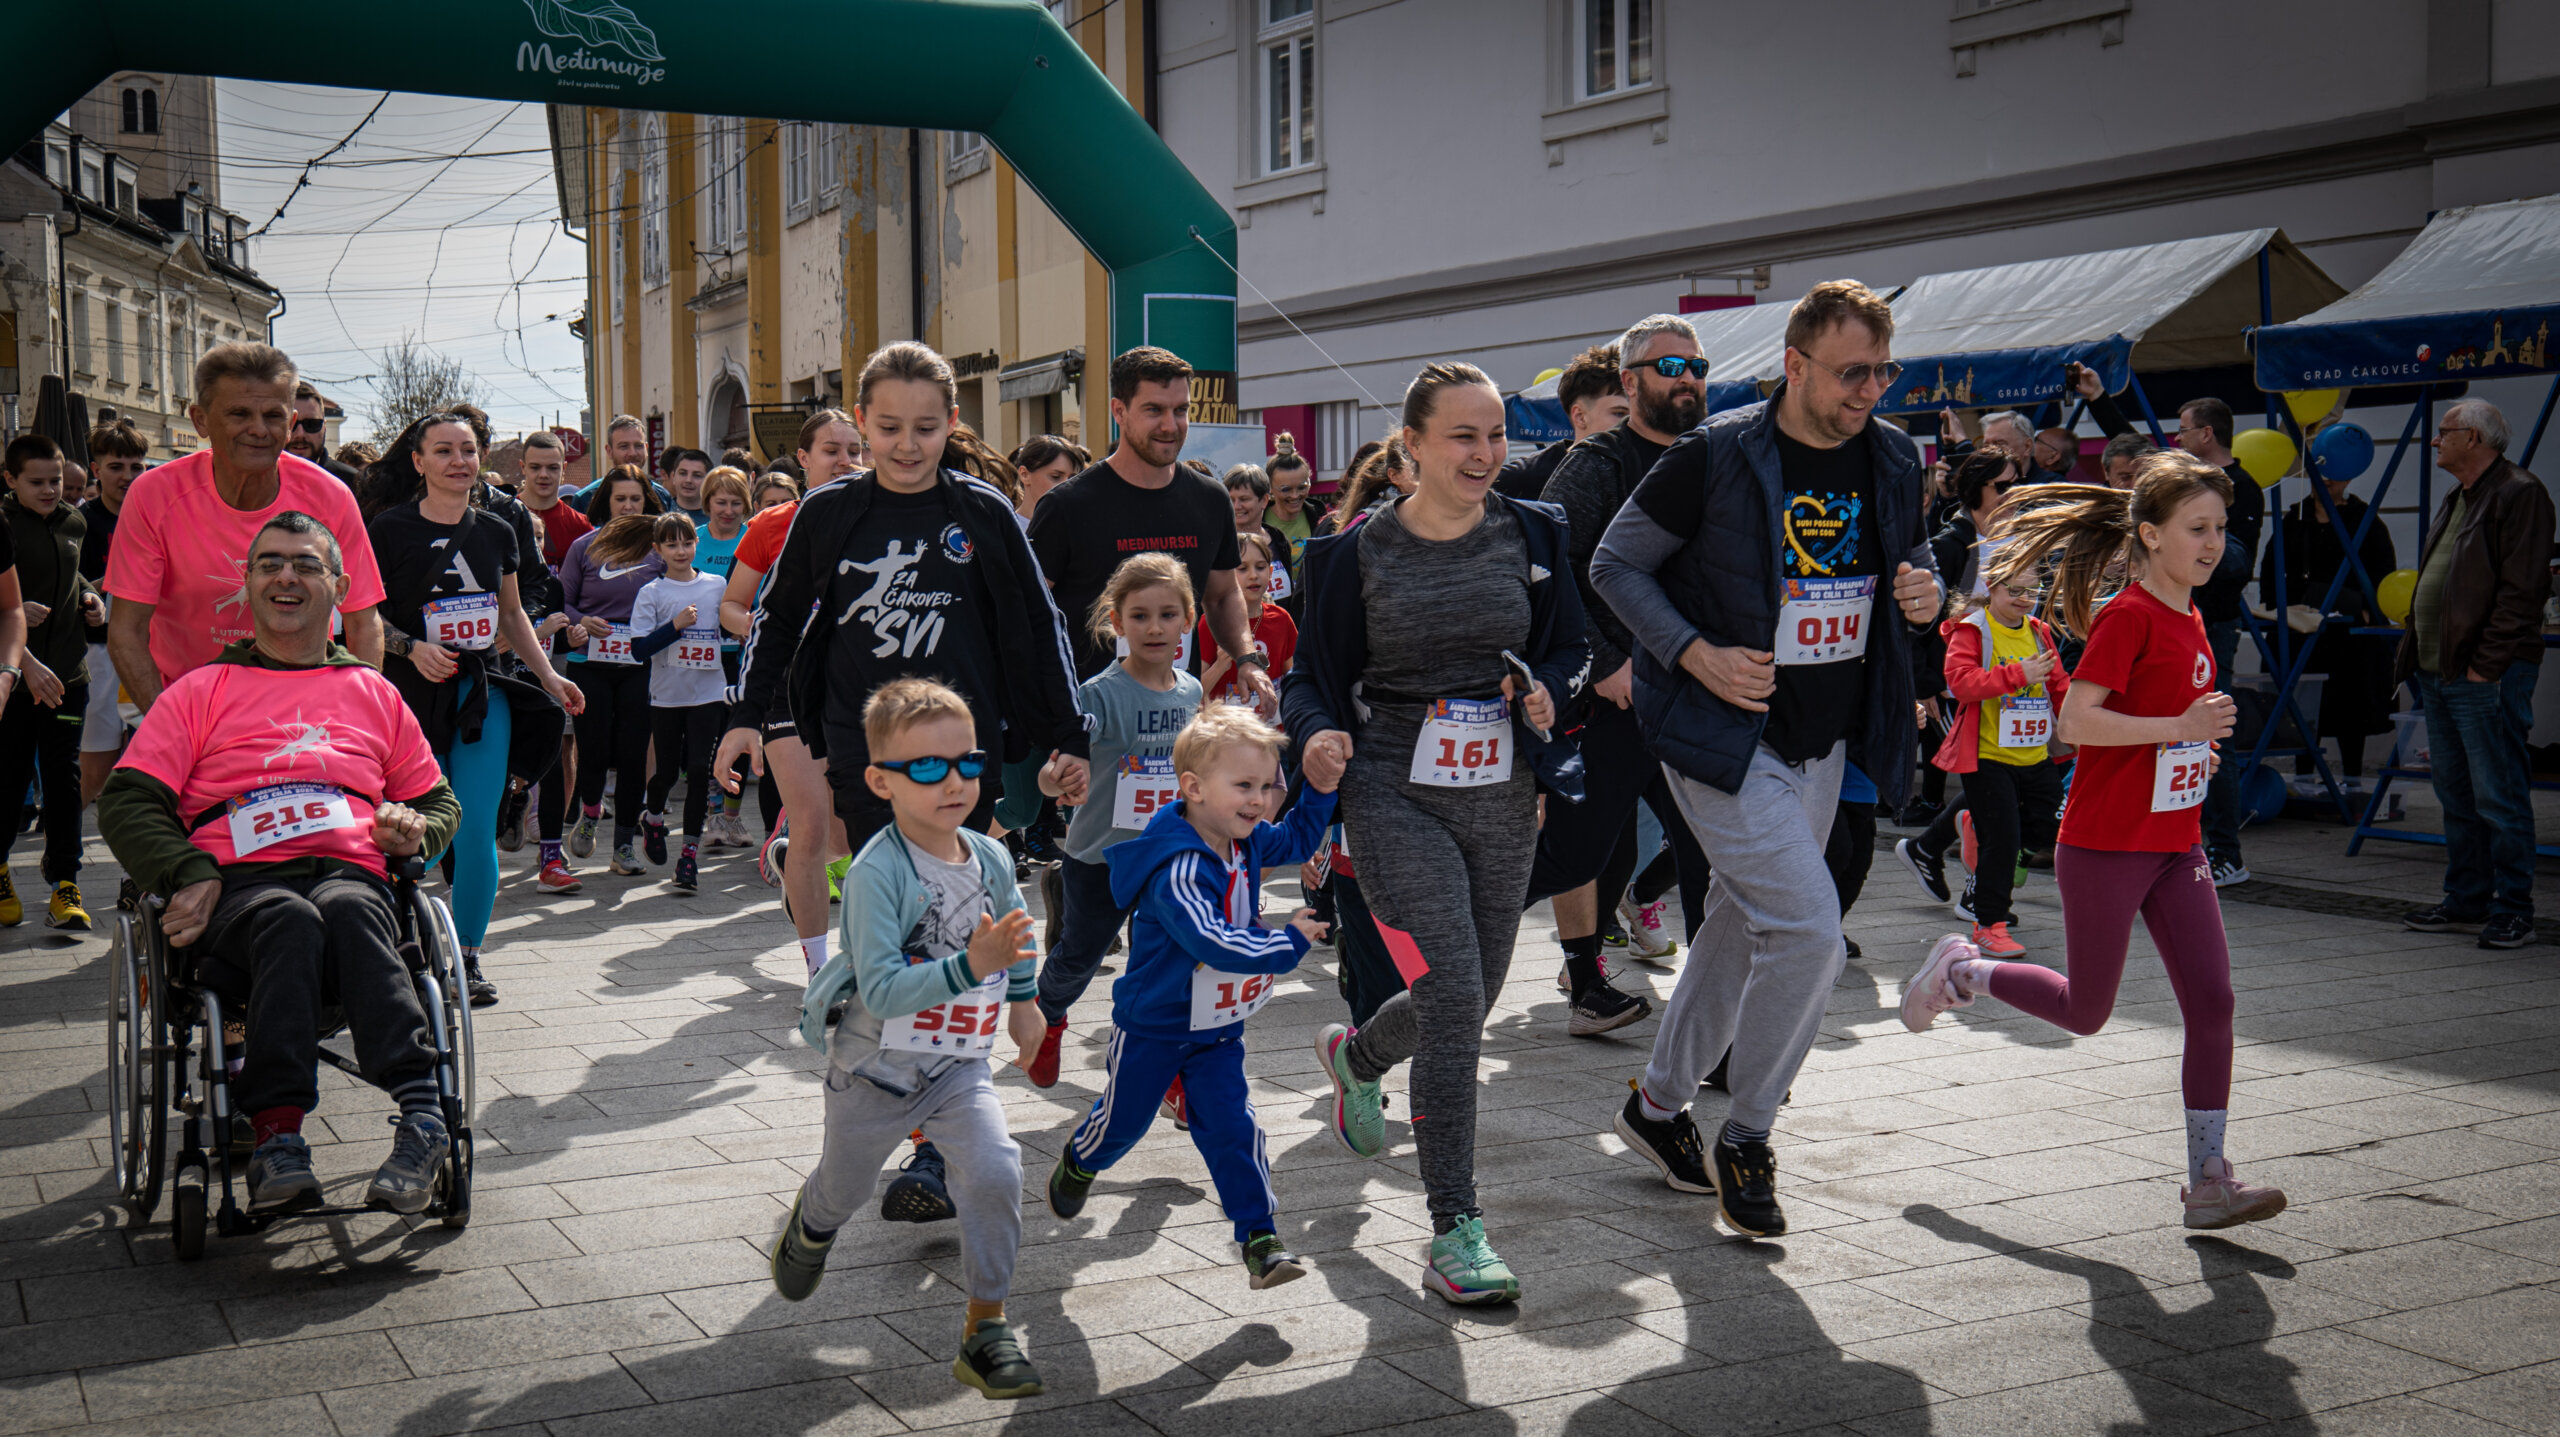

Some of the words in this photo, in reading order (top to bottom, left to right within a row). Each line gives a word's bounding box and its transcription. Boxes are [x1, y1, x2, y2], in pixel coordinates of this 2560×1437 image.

[516, 40, 666, 85] Međimurje
[583, 81, 621, 90] pokretu
[2303, 369, 2342, 380] GRAD
[2351, 363, 2421, 378] ČAKOVEC
[1190, 377, 1226, 403] OLU
[1998, 387, 2028, 398] GRAD
[2034, 384, 2064, 396] ČAKO
[1188, 402, 1238, 424] RATON
[1519, 428, 1542, 437] GRAD
[1547, 426, 1574, 437] ČAKOV
[1796, 520, 1812, 528] BUDI
[1813, 520, 1843, 528] POSEBAN
[1802, 529, 1818, 537] BUDI
[1819, 529, 1836, 537] COOL
[892, 570, 919, 589] ZA
[1266, 578, 1285, 592] 12
[1823, 591, 1841, 599] CILJA
[220, 629, 255, 637] UTRKA
[440, 618, 491, 641] 508
[871, 608, 946, 658] SVI
[1797, 614, 1861, 645] 014
[598, 639, 632, 654] 127
[678, 646, 715, 661] 128
[1137, 707, 1187, 734] LEARN
[1453, 712, 1464, 720] DO
[1466, 714, 1485, 722] CILJA
[2011, 718, 2047, 736] 159
[1137, 734, 1157, 742] FROM
[1435, 737, 1499, 768] 161
[258, 776, 266, 784] 5.
[271, 790, 293, 799] CILJA
[1134, 789, 1181, 813] 55
[253, 802, 330, 835] 216
[913, 1001, 1000, 1036] 552
